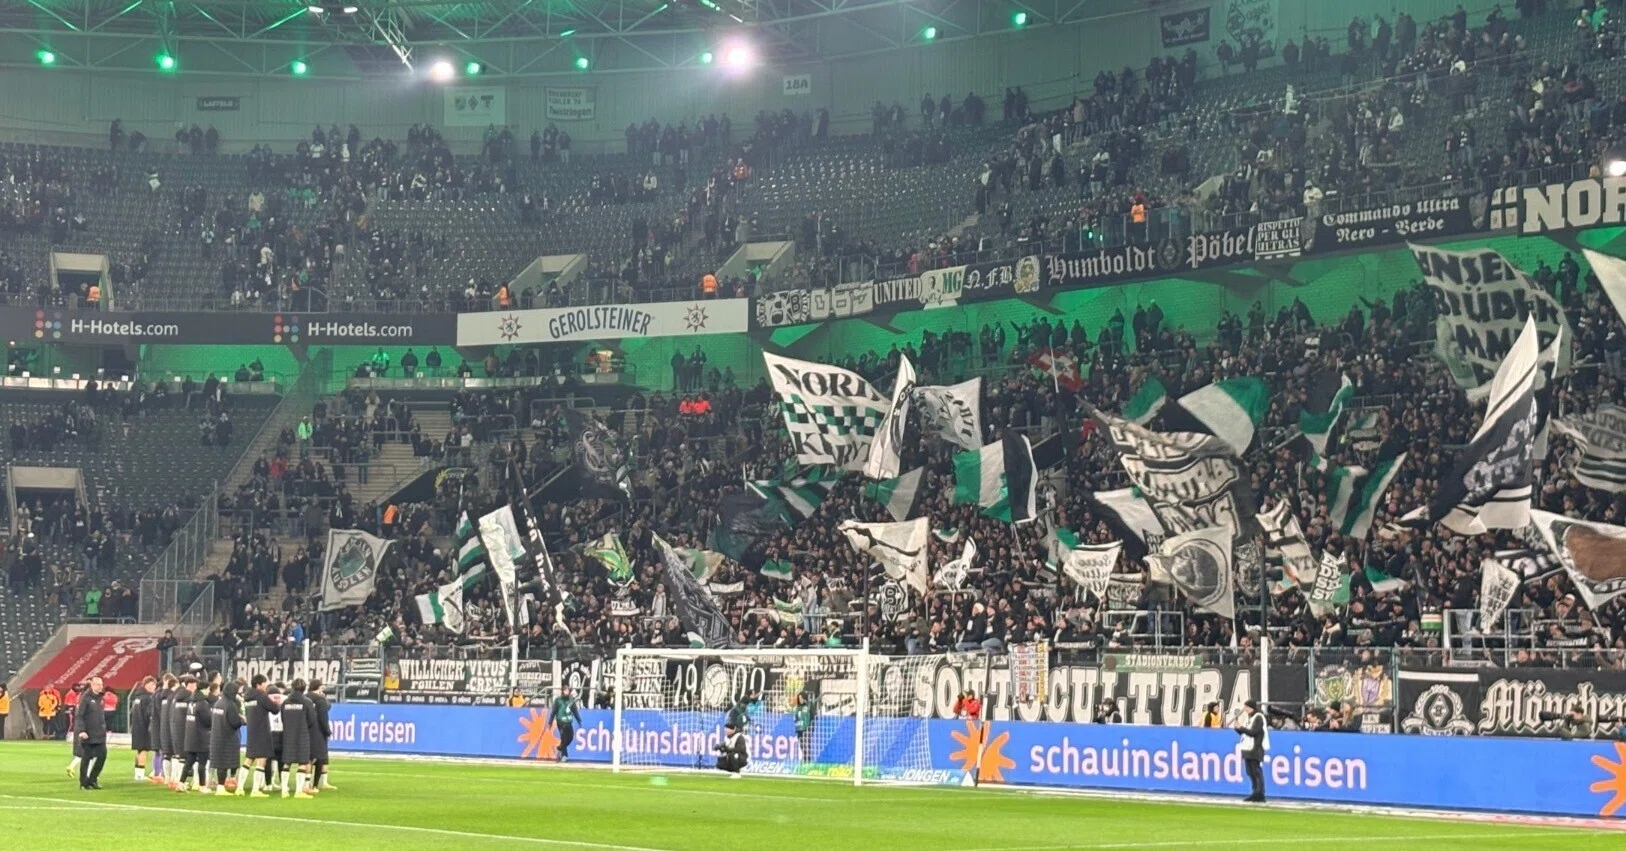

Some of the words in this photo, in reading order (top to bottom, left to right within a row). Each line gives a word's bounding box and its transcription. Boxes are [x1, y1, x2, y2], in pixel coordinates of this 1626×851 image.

[786, 79, 808, 90] 18A
[1323, 203, 1411, 227] Commando
[1416, 197, 1460, 213] Ultra
[1258, 219, 1300, 231] RISPETTO
[1336, 227, 1375, 243] Nero
[1395, 217, 1444, 235] Verde
[1258, 231, 1278, 242] PER
[1258, 238, 1300, 251] ULTRAS
[1045, 244, 1156, 285] Humboldt
[1186, 227, 1256, 269] Pöbel
[873, 277, 922, 305] UNITED
[942, 270, 963, 294] MG
[70, 318, 179, 336] H-Hotels.com
[307, 321, 413, 337] H-Hotels.com
[549, 307, 652, 339] GEROLSTEINER
[399, 659, 465, 680] WILLICHER
[1125, 654, 1195, 668] STADIONVERBOT
[410, 680, 455, 690] FOHLEN
[361, 715, 416, 744] reisen
[1029, 736, 1244, 783] schauinsland
[899, 769, 950, 783] JONGEN
